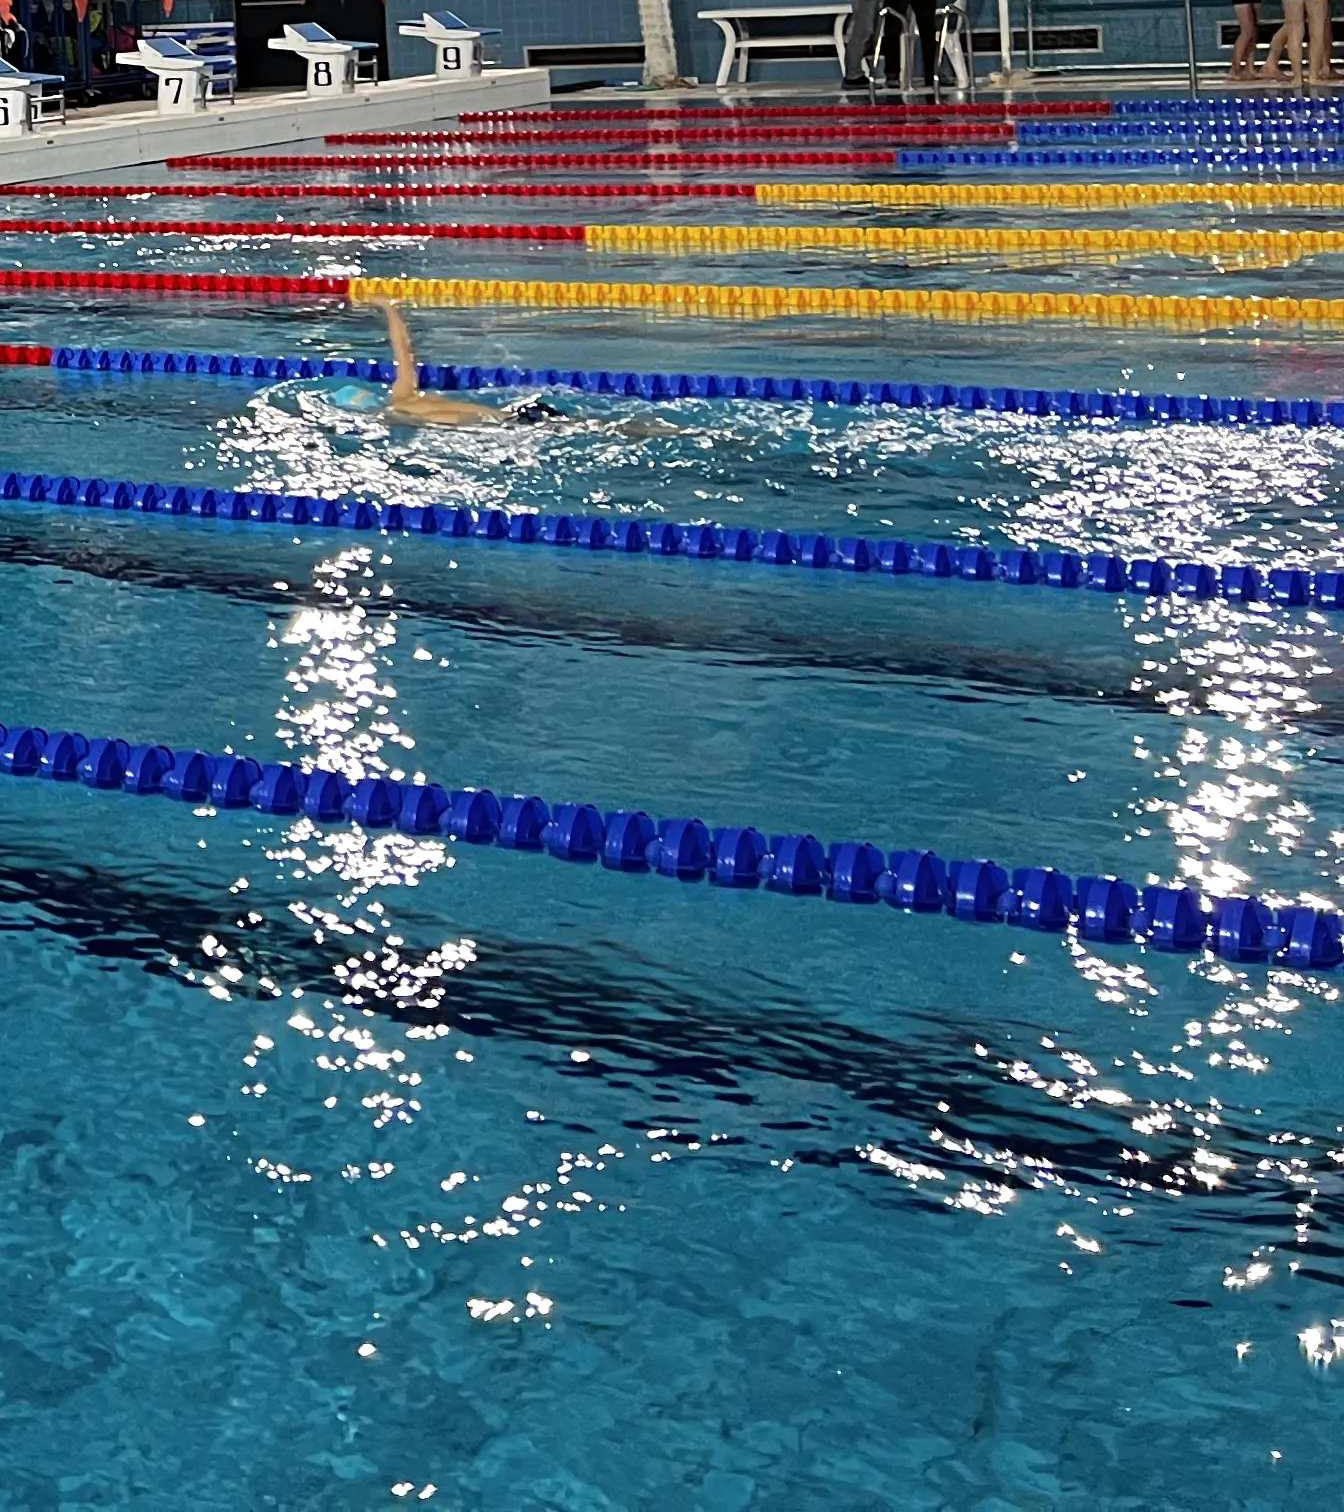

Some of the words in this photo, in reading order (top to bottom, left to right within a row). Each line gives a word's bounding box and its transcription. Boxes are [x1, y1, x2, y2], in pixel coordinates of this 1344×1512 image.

[443, 47, 461, 70] 9
[314, 62, 332, 86] 8
[165, 78, 183, 104] 7
